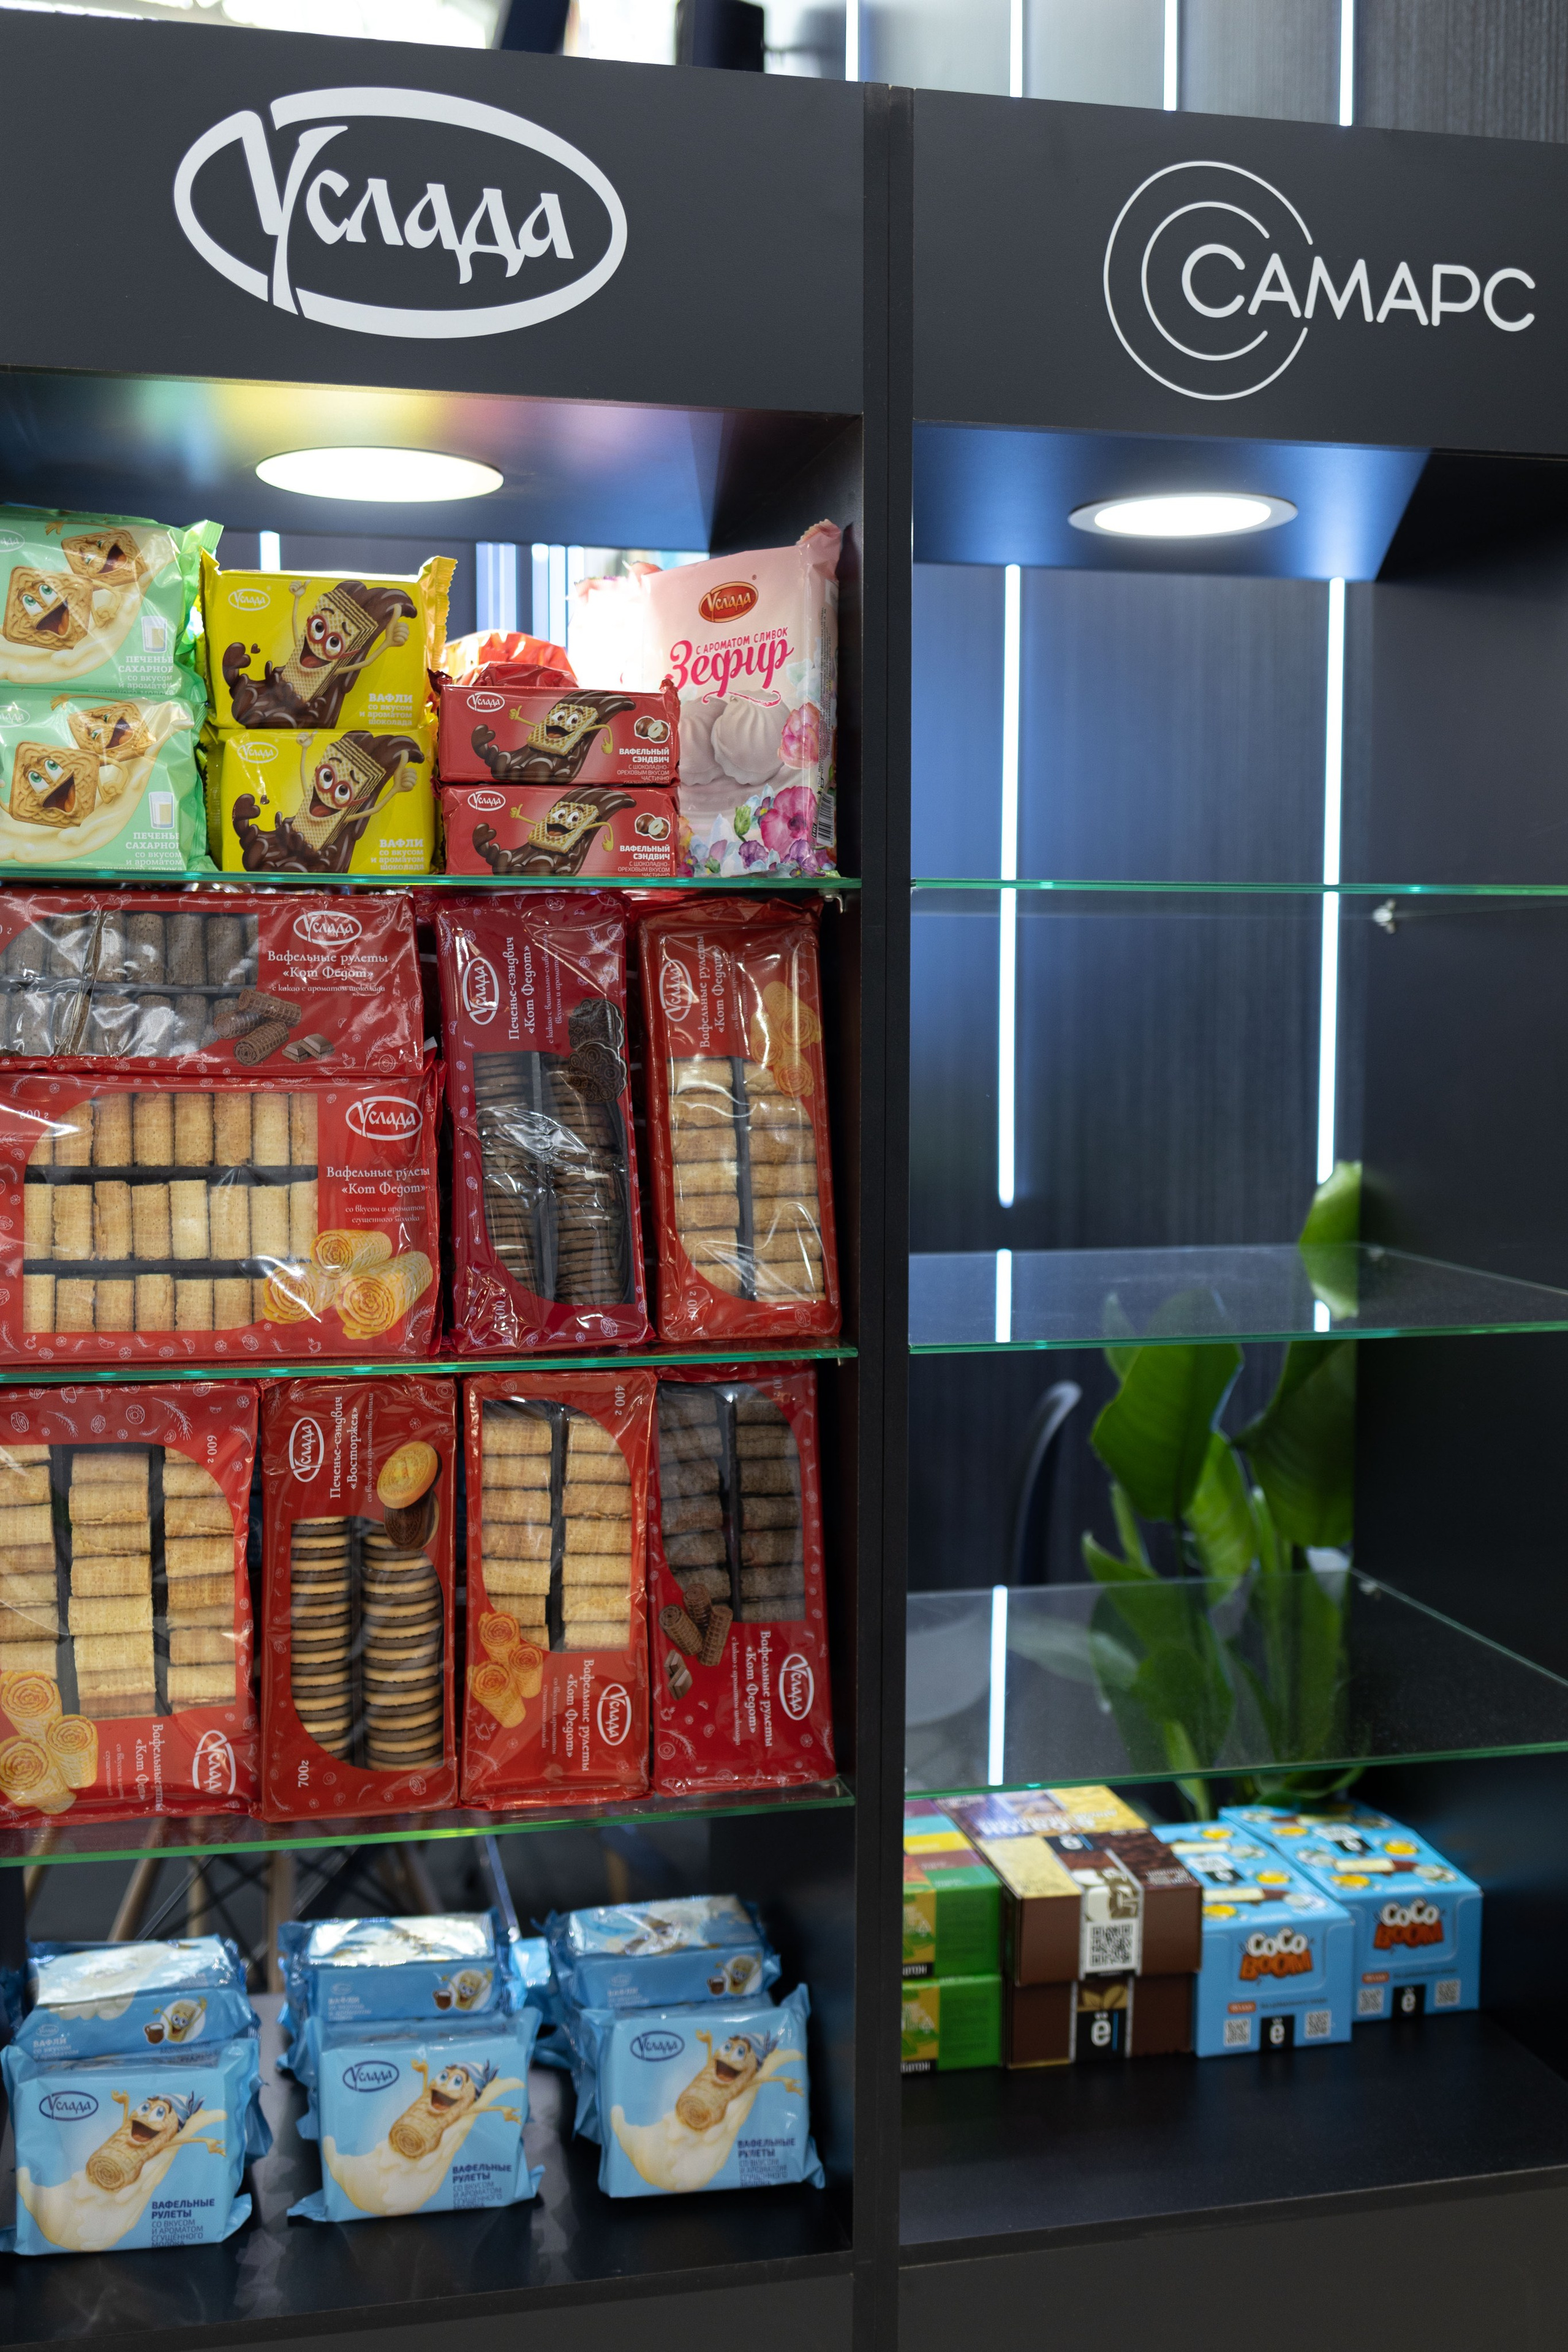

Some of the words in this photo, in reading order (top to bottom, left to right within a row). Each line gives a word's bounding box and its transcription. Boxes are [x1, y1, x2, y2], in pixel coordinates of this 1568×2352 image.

[240, 109, 575, 316] Услада
[1181, 243, 1536, 332] САМАРС
[233, 591, 266, 609] Услада
[706, 591, 752, 622] Услада
[696, 645, 701, 655] С
[703, 635, 750, 654] АРОМАТОМ
[753, 627, 788, 644] СЛИВОК
[665, 639, 794, 698] Зефир
[369, 693, 413, 703] ВАФЛИ
[472, 694, 501, 711] Услада
[241, 745, 274, 761] Услада
[619, 747, 669, 755] ВАФЕЛЬНЫЙ
[472, 793, 502, 810] Услада
[380, 839, 424, 848] ВАФЛИ
[303, 914, 354, 942] Услада
[268, 950, 337, 965] Вафельные
[341, 955, 388, 965] рулеты
[521, 945, 536, 996] Федот»
[697, 935, 710, 979] рулеты
[282, 967, 318, 978] «Кот
[322, 966, 373, 981] Федот»
[307, 986, 347, 995] ароматом
[349, 984, 385, 993] шоколада
[503, 937, 519, 1040] Печенье-сэндвич
[524, 999, 536, 1034] «Кот
[555, 998, 564, 1024] вкусом
[698, 982, 713, 1048] Вафельные
[715, 1000, 725, 1033] «Кот
[545, 1016, 554, 1041] какао
[357, 1101, 417, 1137] Услада
[326, 1166, 393, 1181] Вафельные
[341, 1183, 375, 1194] «Кот
[379, 1182, 426, 1197] Федот»
[388, 1205, 425, 1214] ароматом
[615, 1385, 625, 1406] 400
[207, 1435, 217, 1455] 600
[293, 1424, 322, 1474] Услада
[330, 1396, 346, 1499] Печенье-сэндвич
[365, 1467, 375, 1492] вкусом
[745, 1646, 756, 1680] «Кот
[758, 1630, 772, 1698] Вафельные
[567, 1674, 578, 1706] «Кот
[579, 1659, 595, 1723] Вафельные
[782, 1662, 809, 1713] Услада
[601, 1691, 627, 1738] Услада
[744, 1683, 759, 1734] Федот»
[562, 1708, 579, 1758] Федот»
[760, 1700, 772, 1747] рулеты
[135, 1738, 147, 1771] «Кот
[578, 1725, 590, 1772] рулеты
[298, 1759, 309, 1788] 700г
[636, 2035, 678, 2060] Услада
[350, 2066, 393, 2092] Услада
[48, 2095, 91, 2119] Услада
[452, 2163, 512, 2174] ВАФЕЛЬНЫЕ
[453, 2172, 491, 2184] РУЛЕТЫ
[151, 2209, 192, 2219] РУЛЕТЫ
[152, 2198, 215, 2209] ВАФЕЛЬНЫЕ
[151, 2232, 203, 2242] СГУЩЕННОГО
[159, 2225, 203, 2234] АРОМАТОМ
